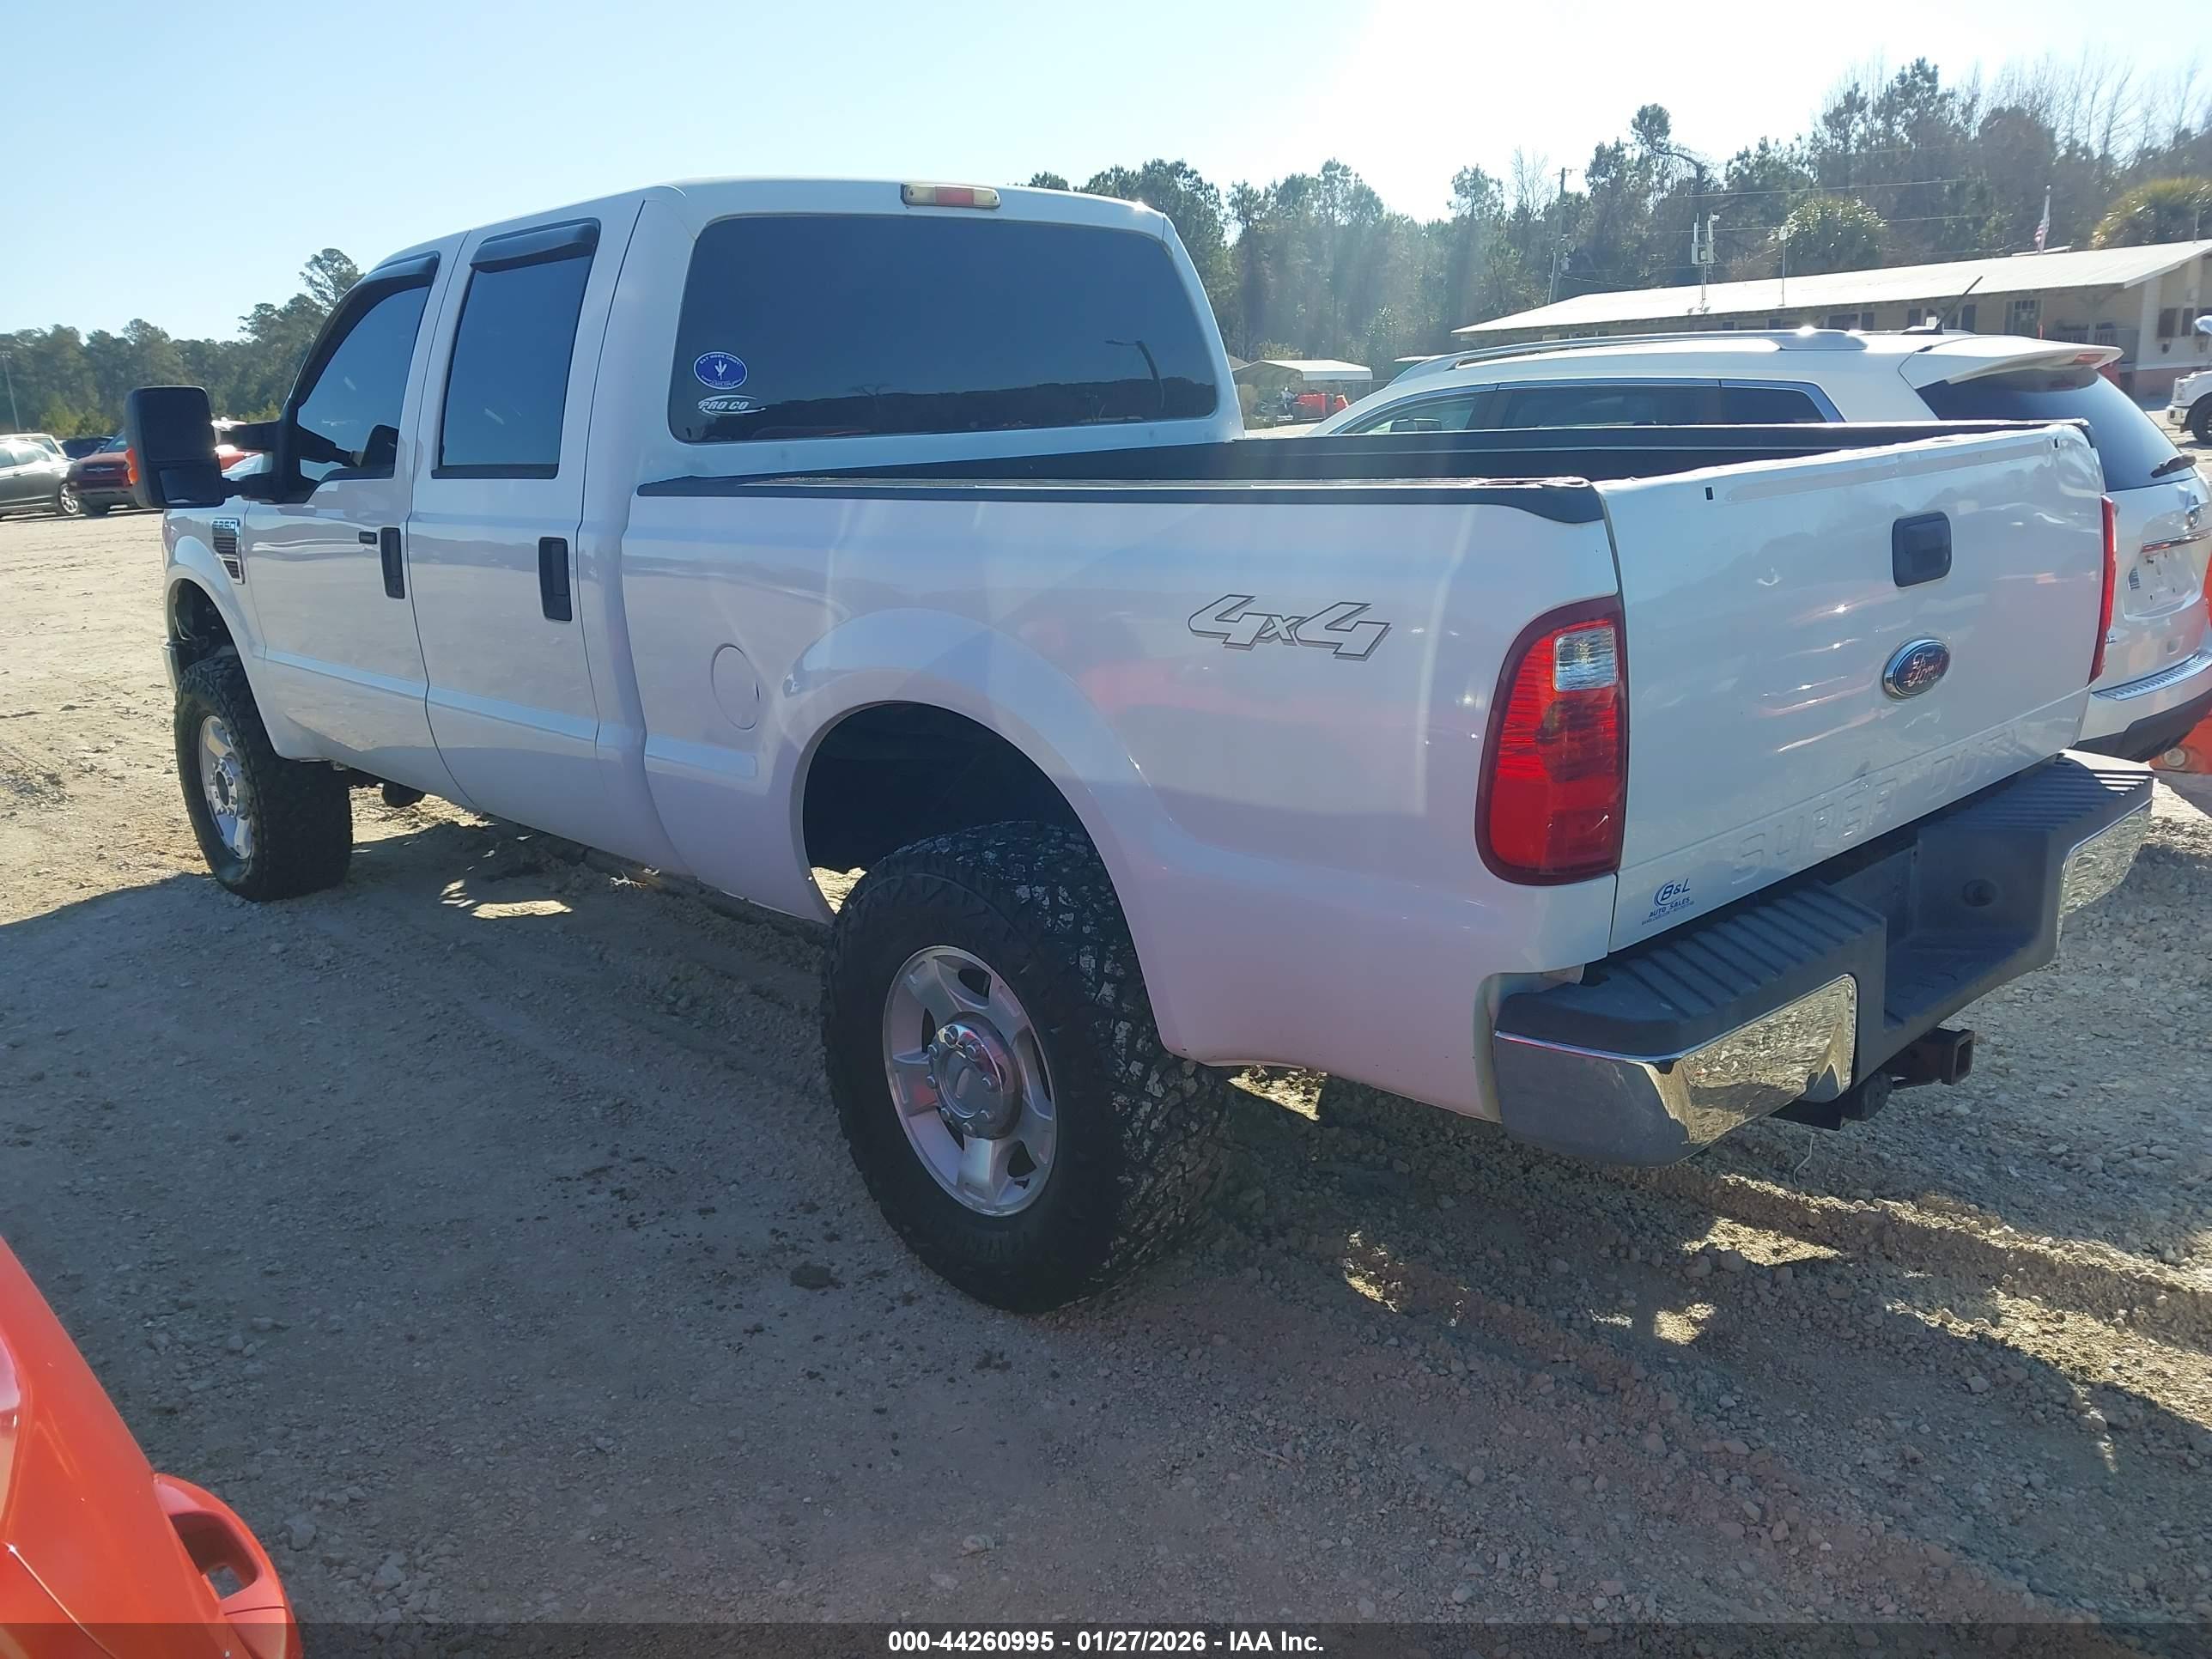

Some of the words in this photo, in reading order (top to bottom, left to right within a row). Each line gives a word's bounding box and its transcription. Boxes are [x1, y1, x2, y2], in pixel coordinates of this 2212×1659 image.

[697, 401, 728, 410] PRO
[728, 401, 750, 410] CO
[1660, 878, 1691, 902] B&L
[1649, 907, 1667, 918] AUTO
[1669, 896, 1691, 908] SALES
